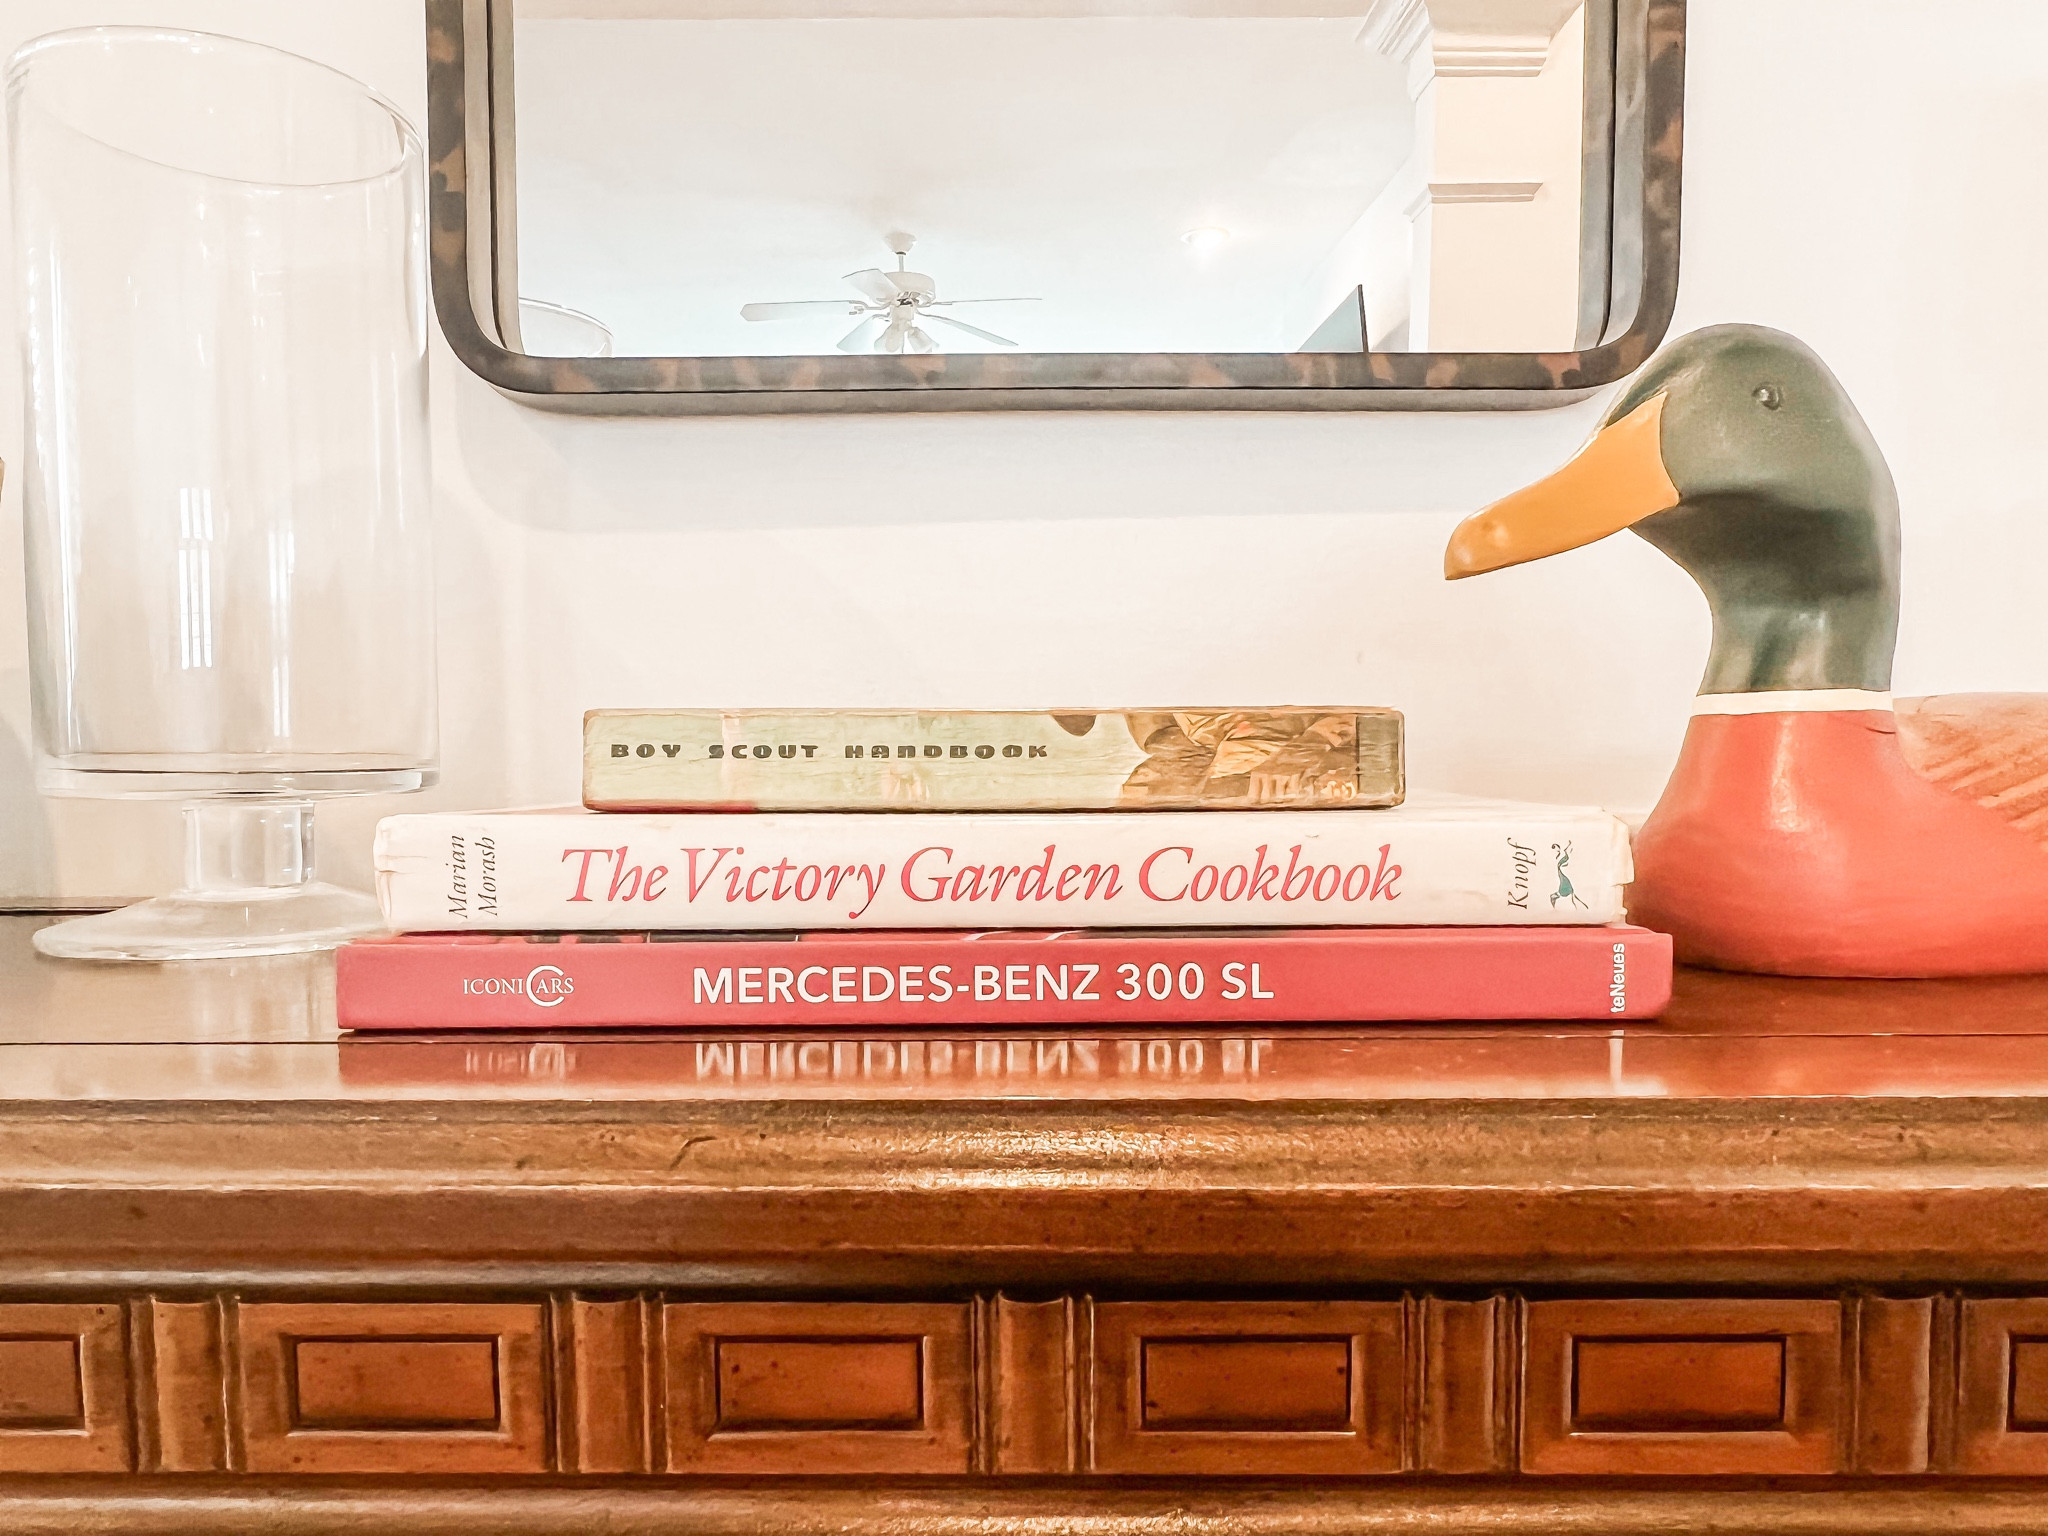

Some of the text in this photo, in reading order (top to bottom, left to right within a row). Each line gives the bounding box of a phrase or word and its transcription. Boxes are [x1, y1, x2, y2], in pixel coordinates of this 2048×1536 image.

[610, 742, 1048, 760] BOY SCOUT HANDBOOK
[446, 835, 468, 919] Marian
[476, 836, 499, 917] Morash
[561, 842, 1403, 919] The Victory Garden Cookbook
[1506, 837, 1537, 909] Knopf
[693, 961, 1274, 1004] MERCEDES-BENZ 300 SL
[1609, 942, 1625, 1013] teNeues
